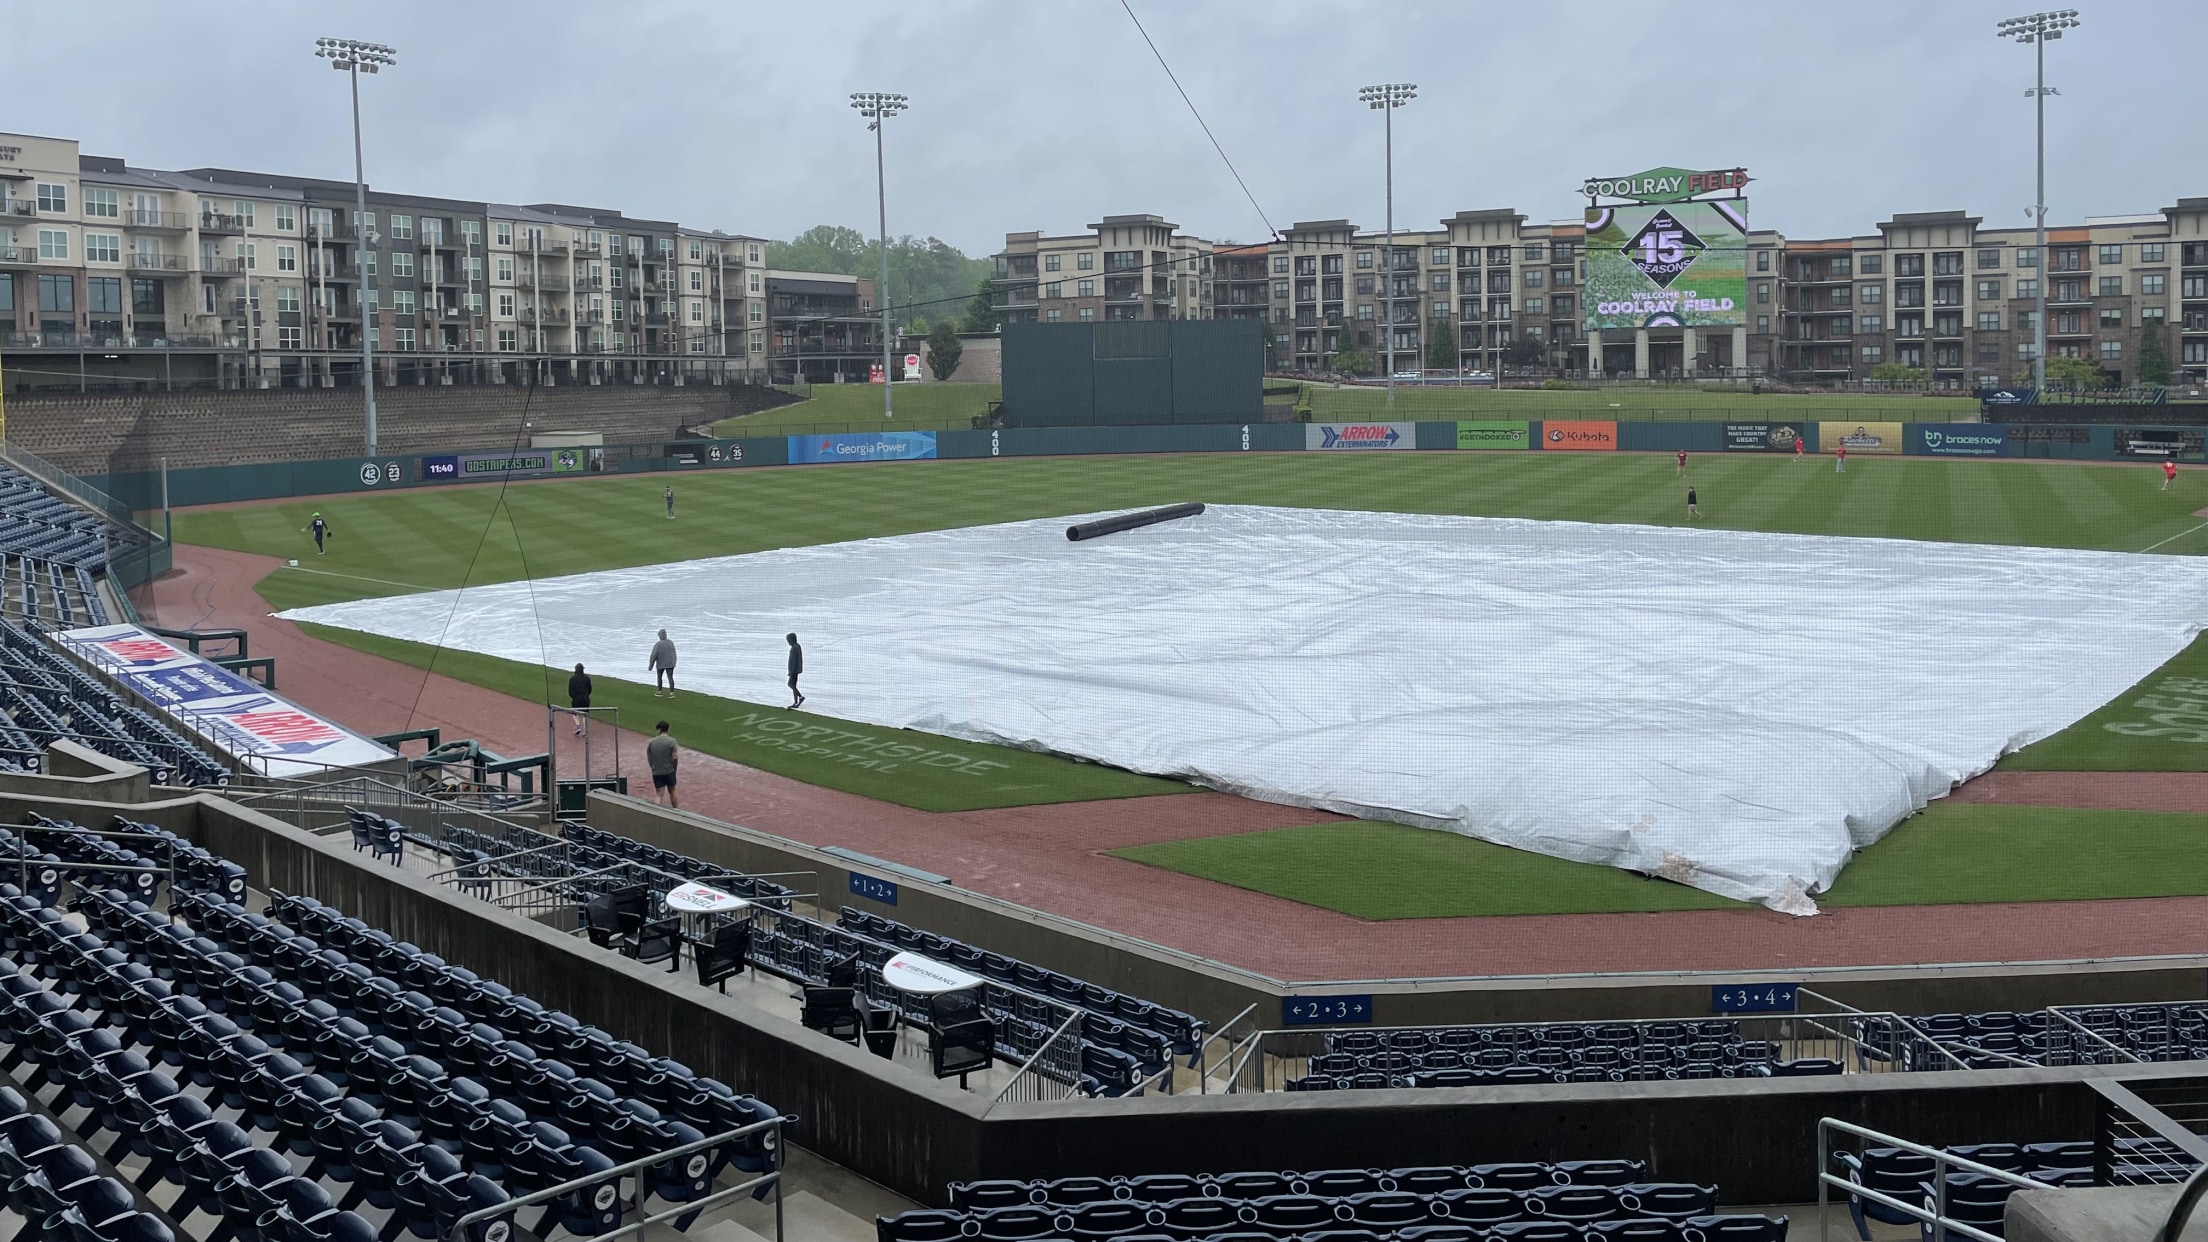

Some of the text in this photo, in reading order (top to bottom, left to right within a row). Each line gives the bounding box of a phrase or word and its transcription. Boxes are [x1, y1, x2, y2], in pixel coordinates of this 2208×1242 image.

[1583, 171, 1748, 198] COOLRAY FIELD
[1640, 230, 1684, 264] 15
[1637, 259, 1691, 274] SEASONS
[1631, 290, 1697, 300] WELCOME TO
[1597, 298, 1734, 315] COOLRAY FIELD
[1242, 424, 1250, 451] 400
[1340, 426, 1389, 440] ARROW
[1567, 431, 1609, 441] Kubota
[1946, 434, 2002, 445] braces now
[836, 441, 906, 456] Georgia Power
[991, 430, 999, 456] 400
[1336, 440, 1388, 448] EXTERMINATORS
[711, 449, 721, 458] 44
[732, 449, 743, 457] 35
[430, 464, 454, 474] 11:40
[466, 457, 544, 472] GOSTRIPERS.COM
[364, 469, 376, 479] 42
[388, 467, 400, 478] 23
[724, 713, 1010, 775] NORTHSIDE
[730, 732, 898, 774] HOSPITAL
[877, 884, 884, 897] 2
[906, 965, 958, 986] PERFORMANCE
[1737, 988, 1775, 1007] 3 4
[1308, 1001, 1347, 1018] 2 3
